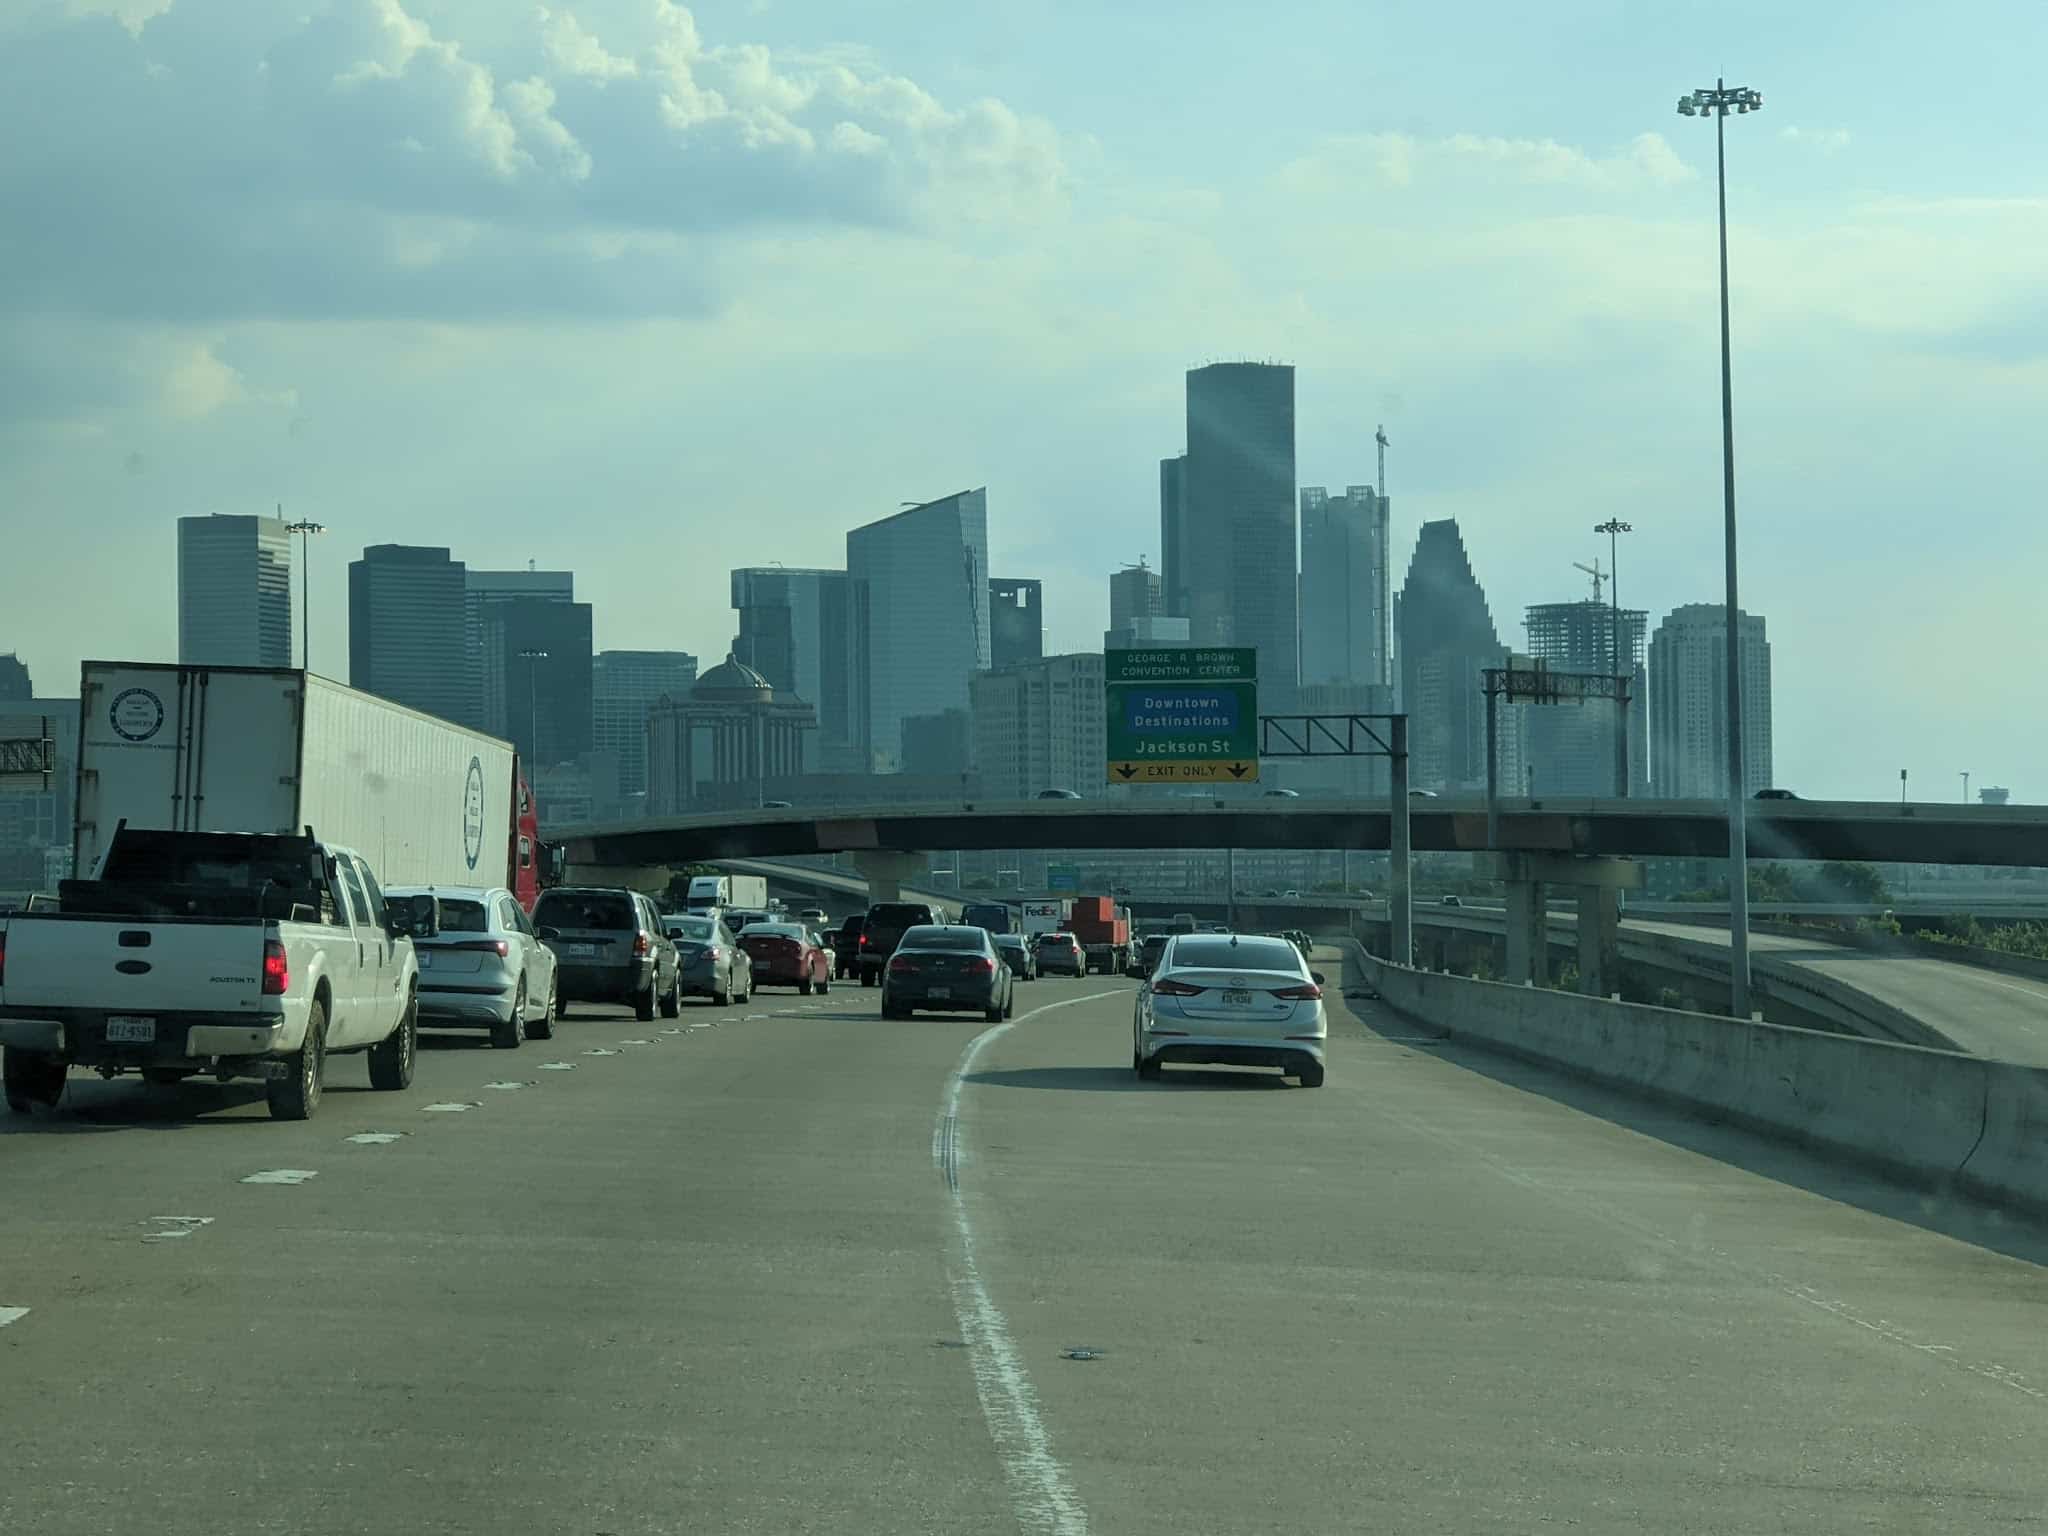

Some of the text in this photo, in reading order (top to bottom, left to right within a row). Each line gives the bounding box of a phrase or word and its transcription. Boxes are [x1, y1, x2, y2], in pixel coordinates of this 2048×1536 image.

[1128, 653, 1170, 663] GEORGE
[1196, 652, 1234, 662] BROWN
[1121, 665, 1240, 676] CONVENTION CENTER
[1144, 697, 1219, 709] Downtown
[1135, 715, 1230, 727] Destinations
[1136, 740, 1230, 753] Jackson St
[1147, 766, 1217, 776] EXIT ONLY
[1025, 905, 1056, 917] FedEx
